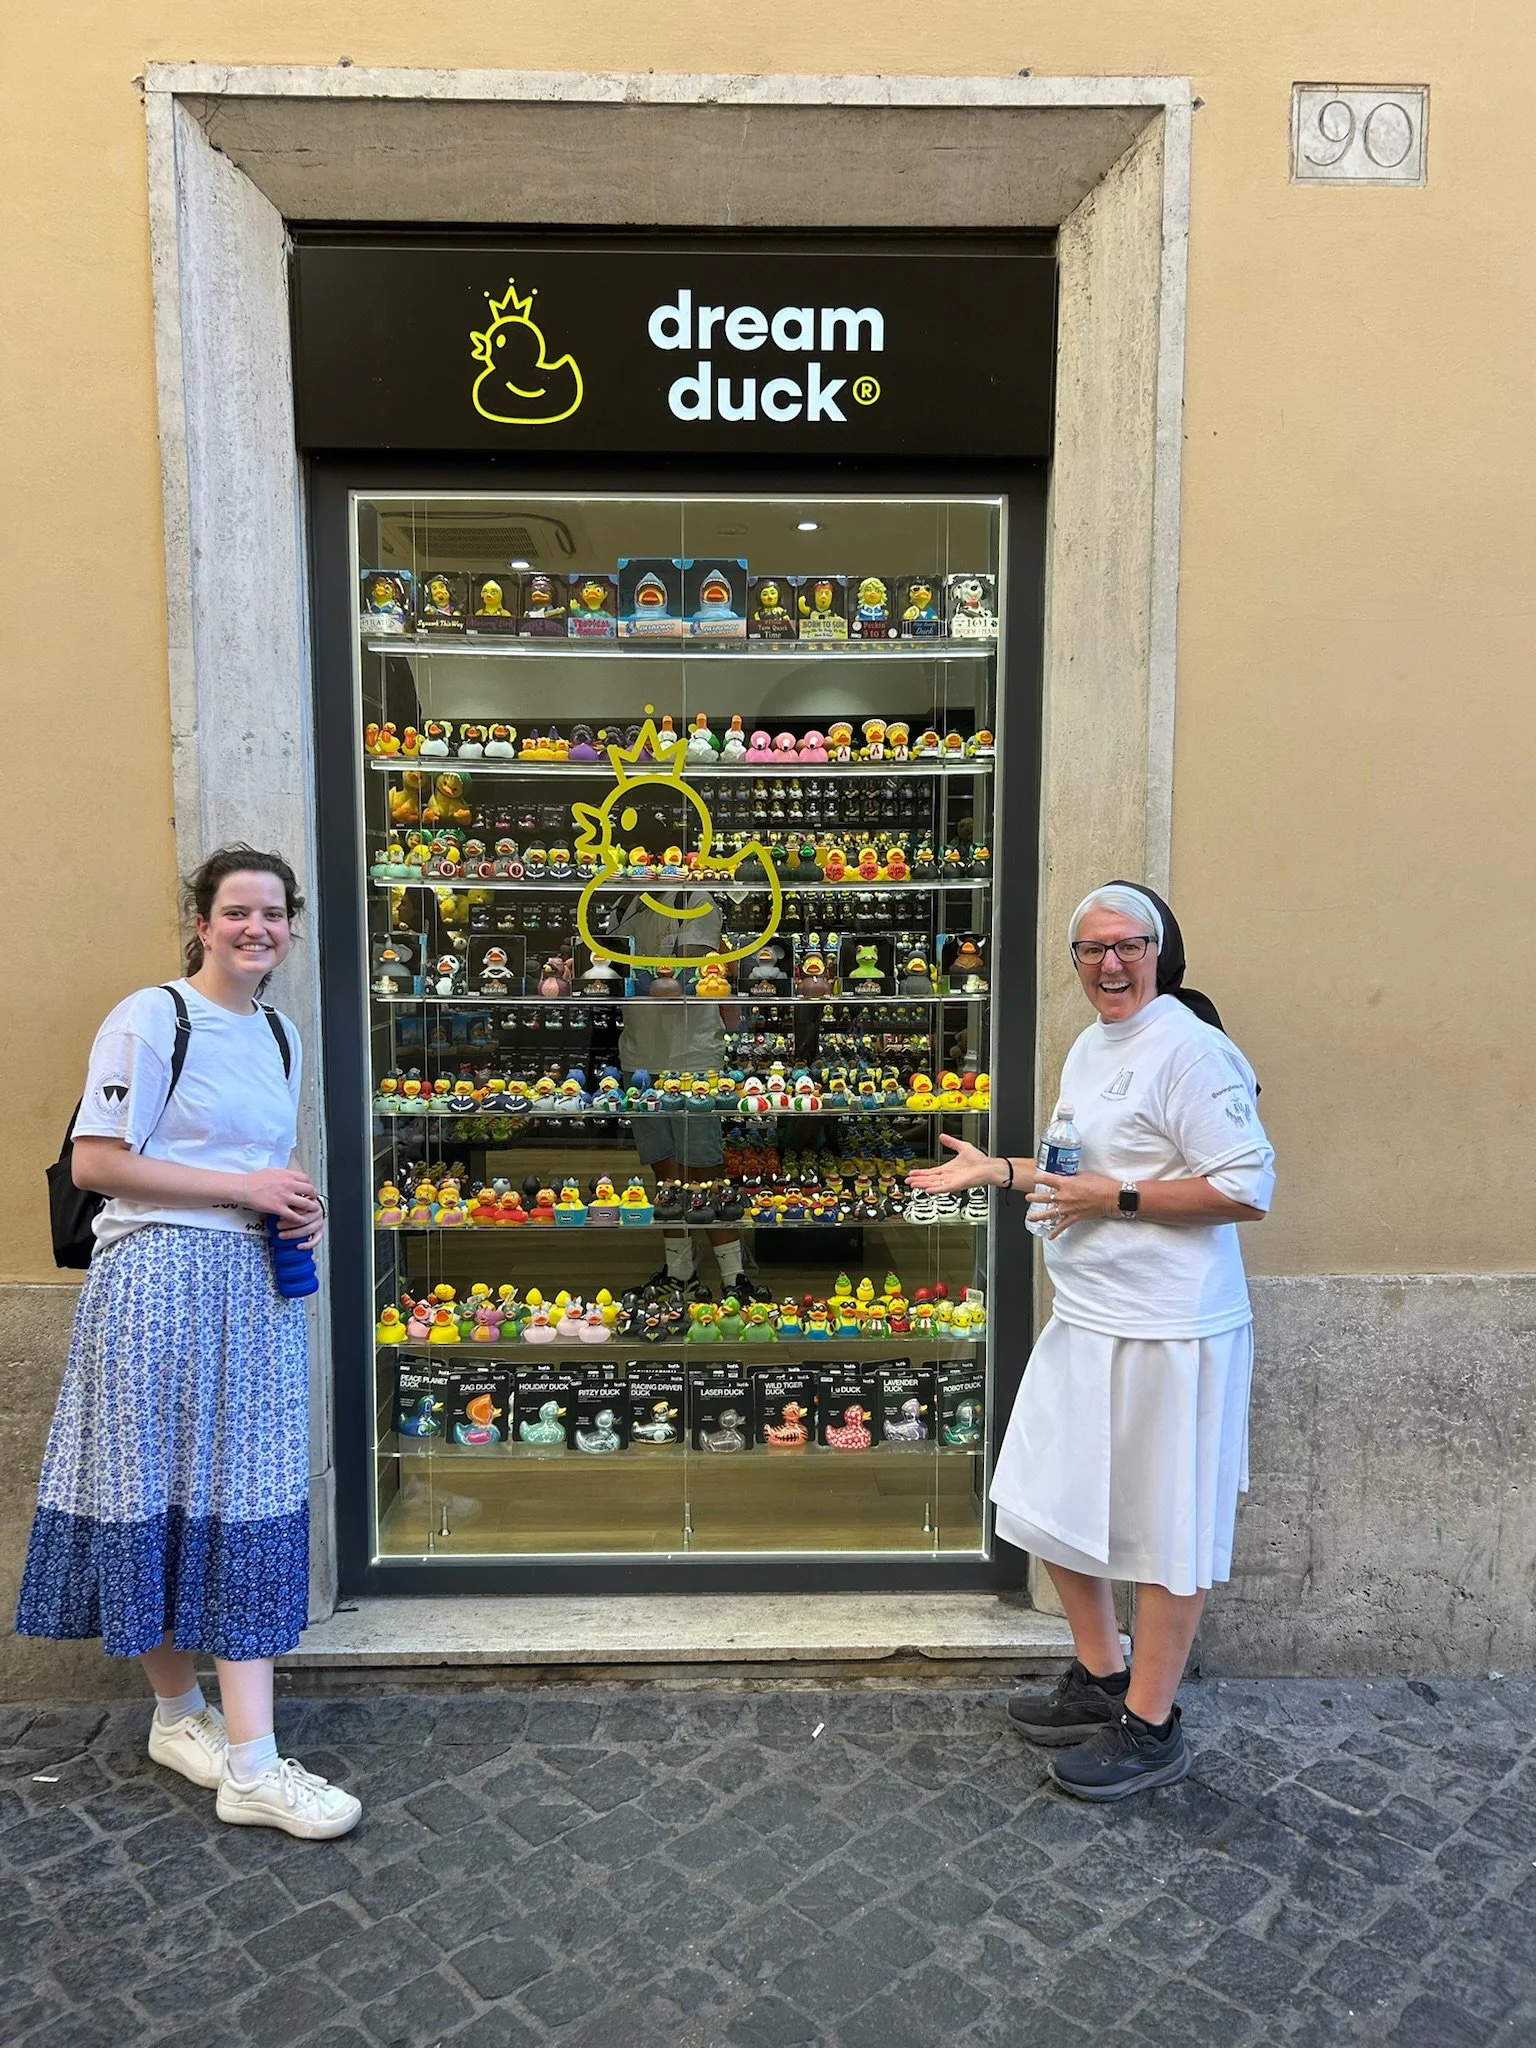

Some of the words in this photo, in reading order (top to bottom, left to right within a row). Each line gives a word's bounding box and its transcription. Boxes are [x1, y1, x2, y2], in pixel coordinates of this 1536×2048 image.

[1304, 100, 1412, 168] 90
[648, 289, 884, 352] dream
[765, 631, 781, 639] Time
[400, 1374, 422, 1383] PEACE
[423, 1376, 449, 1385] PLANET
[400, 1380, 419, 1388] DUCK
[631, 1383, 657, 1391] RACING
[658, 1383, 682, 1391] DRIVER
[783, 1381, 803, 1389] TIGER
[943, 1383, 965, 1393] ROBOT
[964, 1381, 982, 1390] DUCK
[600, 1388, 620, 1396] DUCK
[724, 1388, 744, 1396] DUCK
[765, 1388, 785, 1396] DUCK
